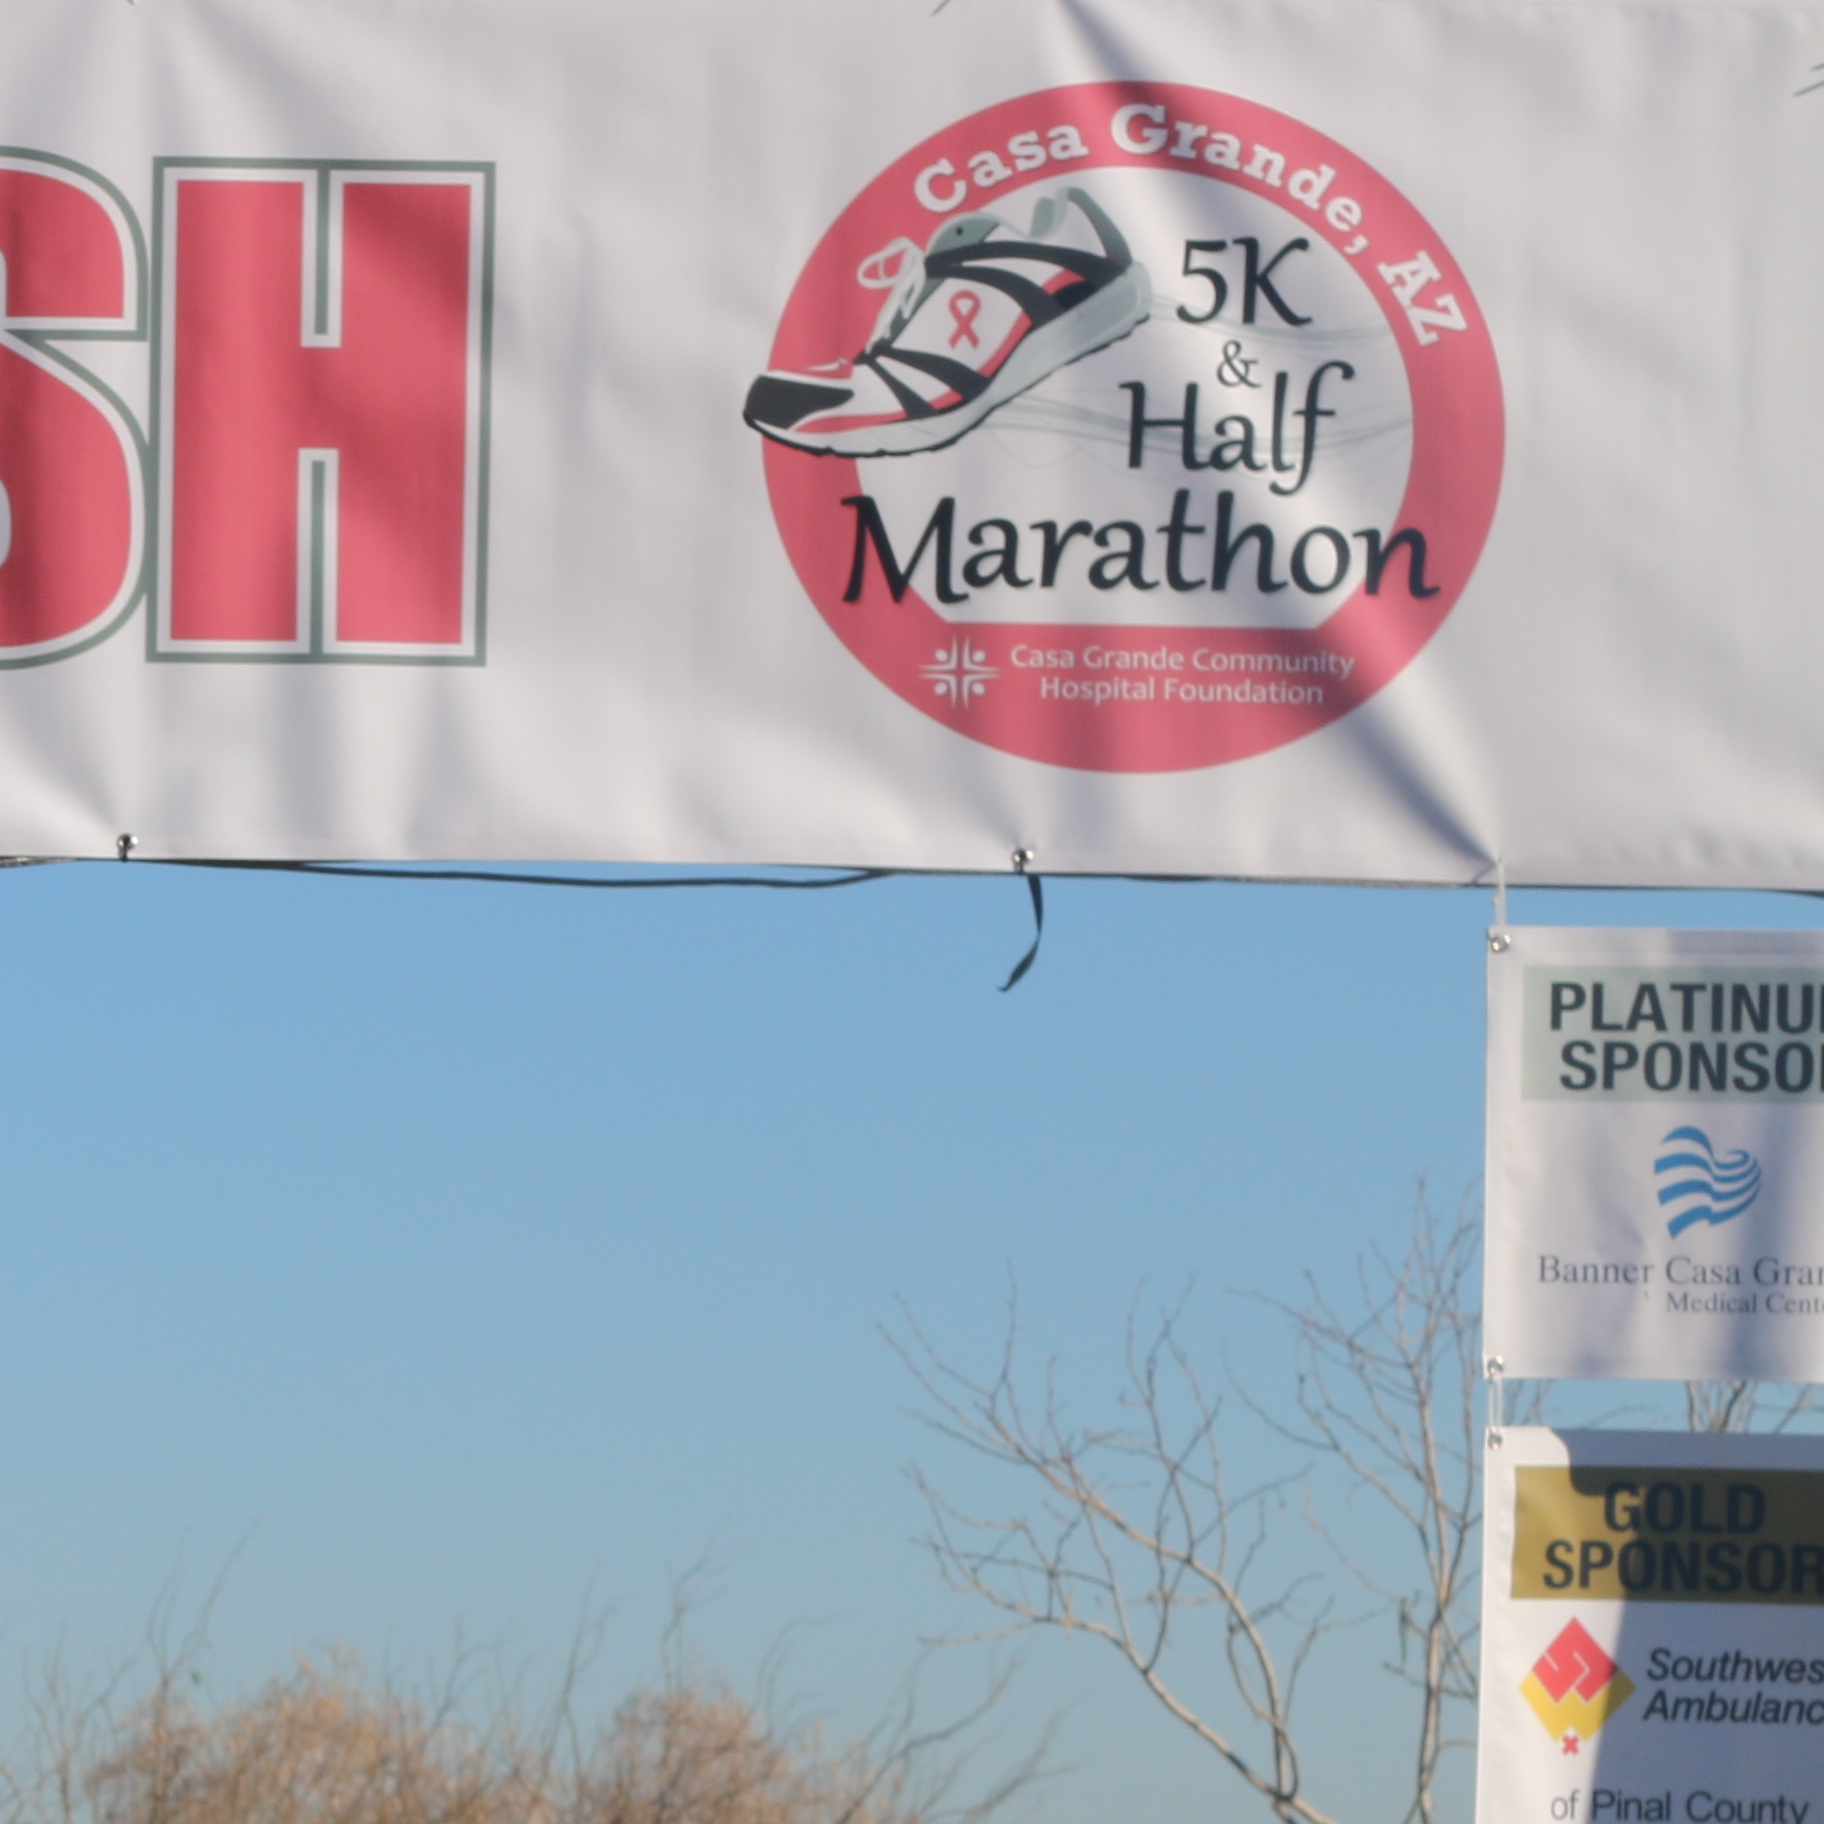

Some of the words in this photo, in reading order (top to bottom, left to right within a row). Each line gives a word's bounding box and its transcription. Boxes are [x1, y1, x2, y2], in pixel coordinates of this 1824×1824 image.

[914, 126, 1088, 212] Casa
[1110, 104, 1372, 256] Grande,
[1376, 250, 1468, 348] AZ
[1176, 237, 1313, 326] 5K
[1216, 341, 1262, 388] &
[1119, 361, 1355, 496] Half
[841, 489, 1440, 604] Marathon
[1011, 645, 1075, 669] Casa
[1083, 646, 1185, 671] Grande
[1192, 648, 1355, 679] Community
[1040, 677, 1155, 705] Hospital
[1164, 679, 1323, 705] Foundation
[1551, 982, 1824, 1034] PLATINU
[1560, 1040, 1824, 1093] SPONSO
[1537, 1256, 1654, 1284] Banner
[1666, 1256, 1741, 1286] Casa
[1666, 1290, 1757, 1314] Medical
[1765, 1292, 1824, 1314] Cent
[1604, 1482, 1766, 1535] GOLD
[1543, 1540, 1824, 1595] SPONSOR
[1647, 1648, 1824, 1685] Southwes
[1643, 1689, 1824, 1725] Ambulanc
[1552, 1790, 1580, 1821] of
[1592, 1791, 1671, 1823] Pinal
